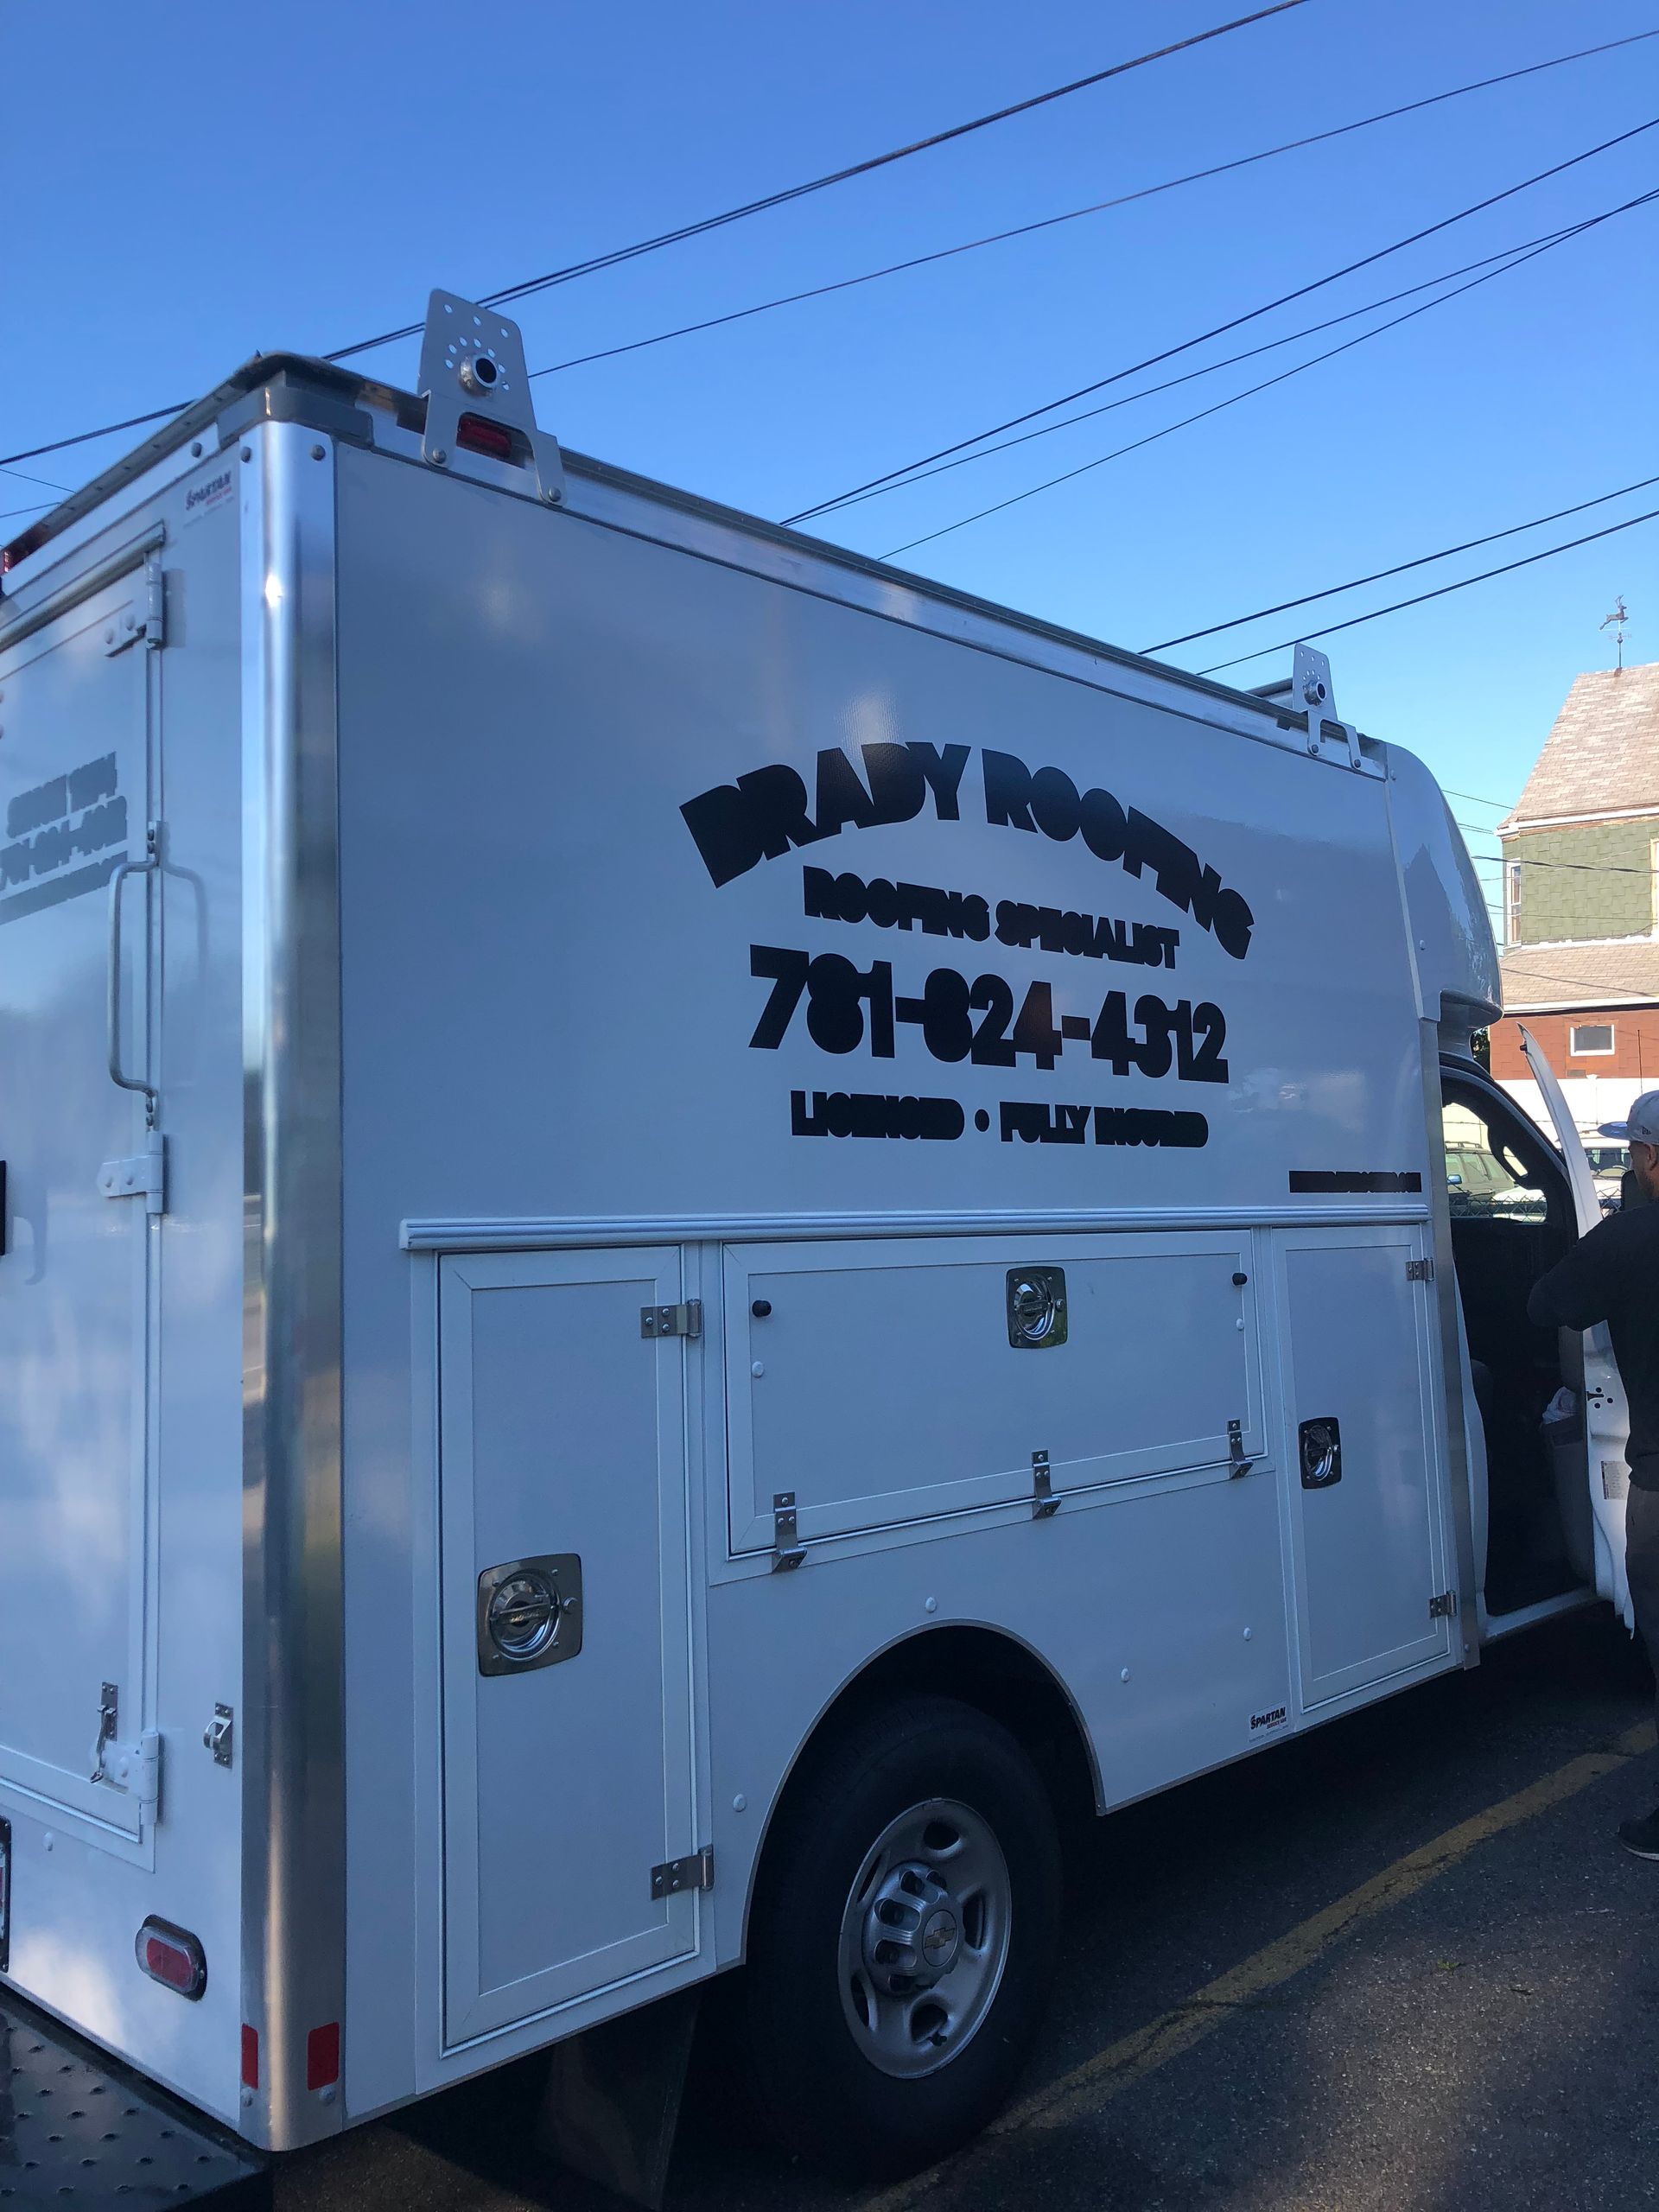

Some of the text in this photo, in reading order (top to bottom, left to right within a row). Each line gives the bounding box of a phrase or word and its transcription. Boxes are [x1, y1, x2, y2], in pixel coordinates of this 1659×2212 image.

[679, 741, 1255, 960] BRADY ROOFING
[804, 865, 1180, 969] ROOFING SPECIALIST
[747, 944, 1230, 1084] 781-824-4312
[1000, 1102, 1092, 1145] FULLY
[1250, 1707, 1286, 1730] SPARTAN
